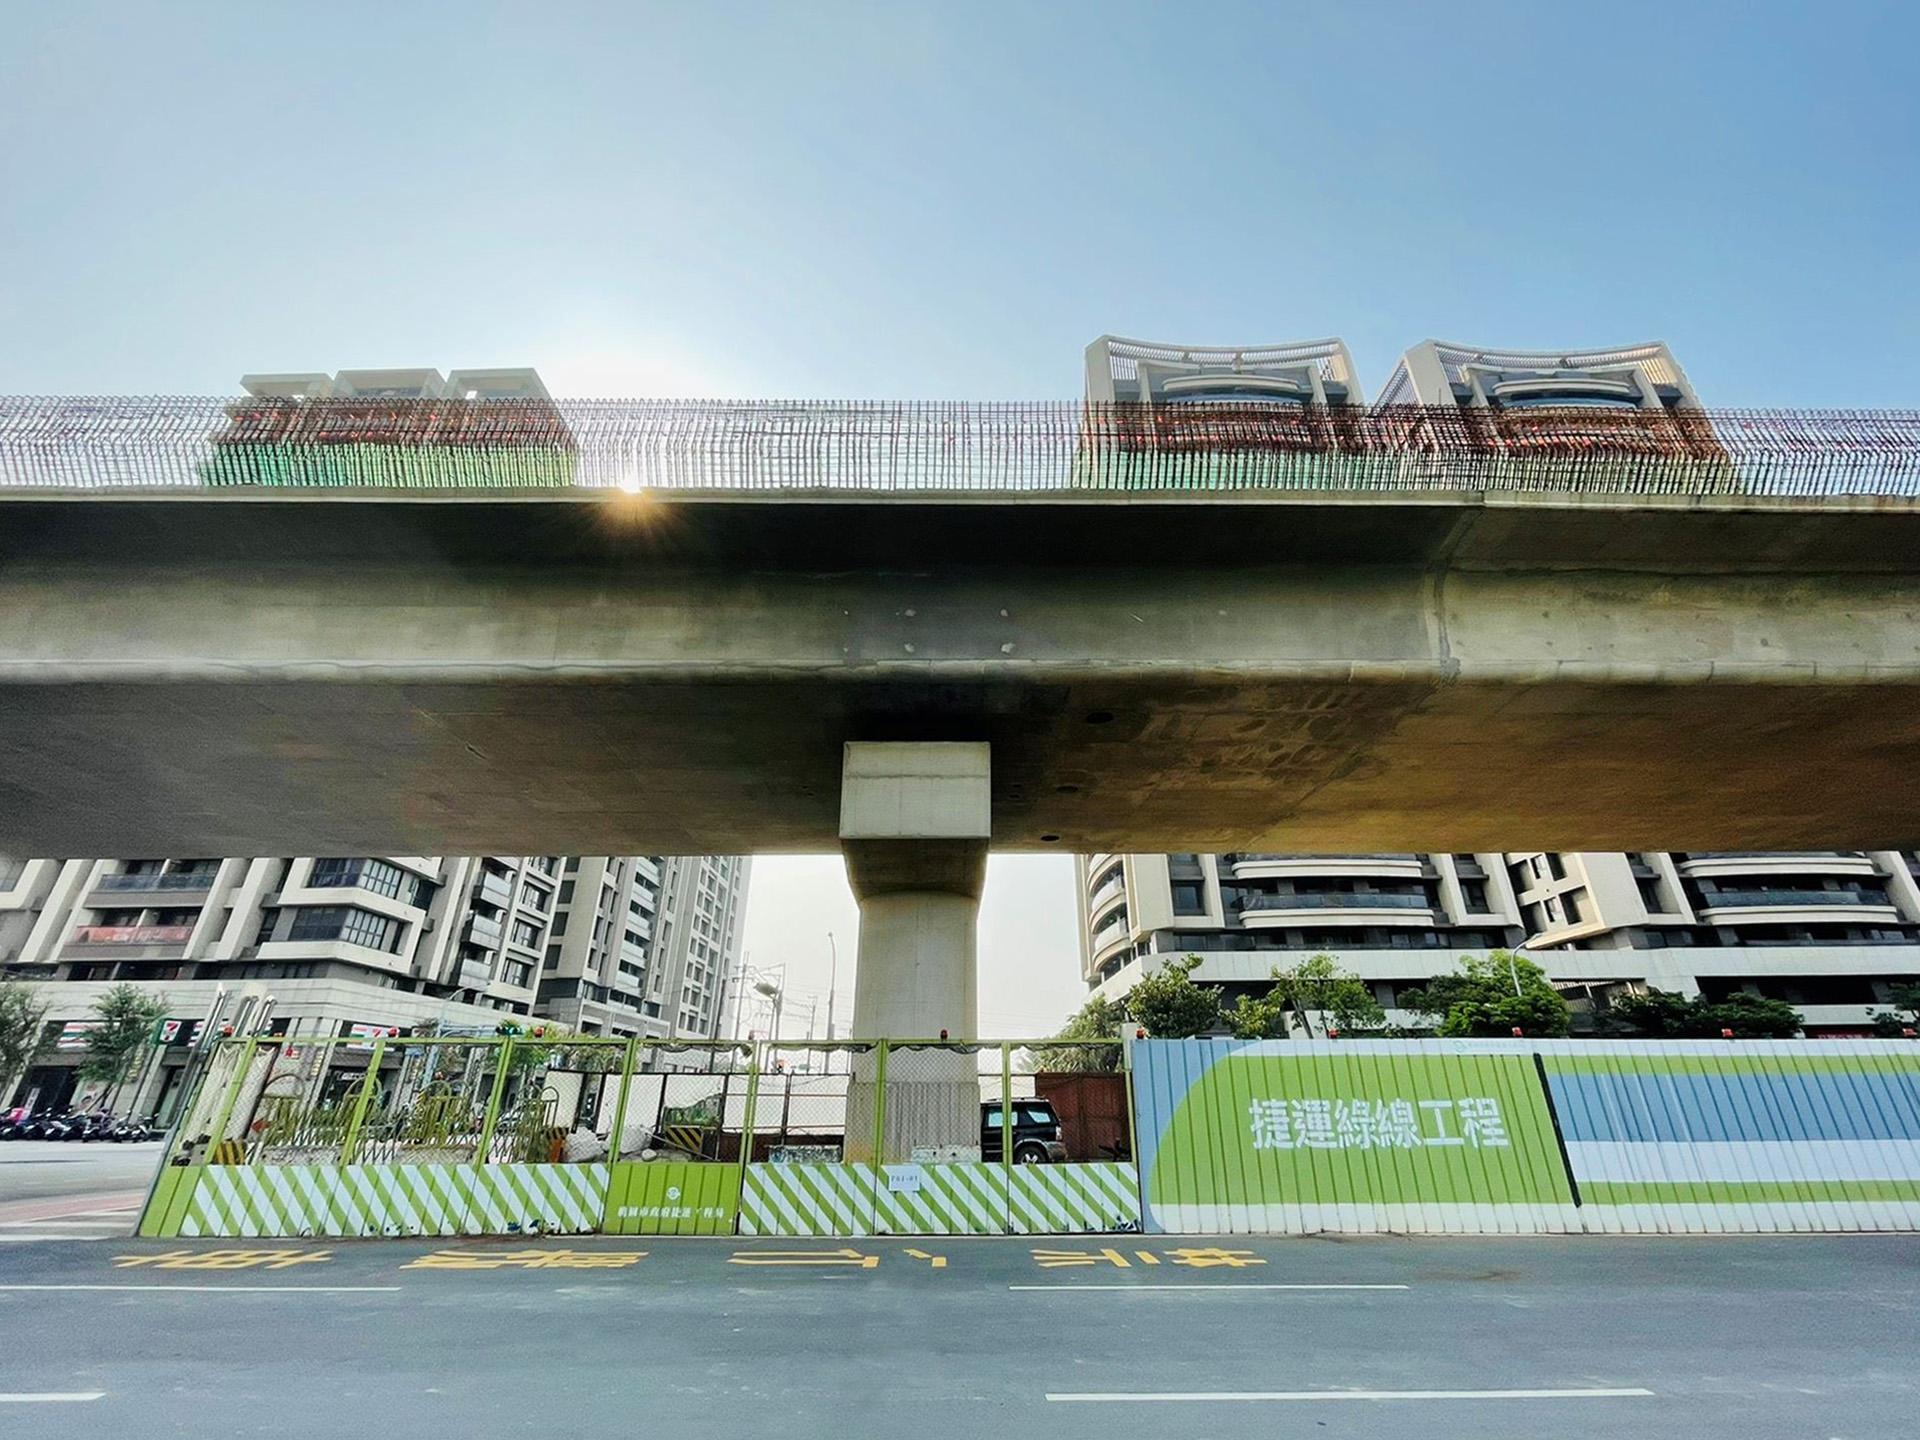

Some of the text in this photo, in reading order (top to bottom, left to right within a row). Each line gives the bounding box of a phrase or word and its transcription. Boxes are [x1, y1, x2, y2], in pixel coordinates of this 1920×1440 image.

[1249, 1098, 1508, 1149] 捷運綠線工程
